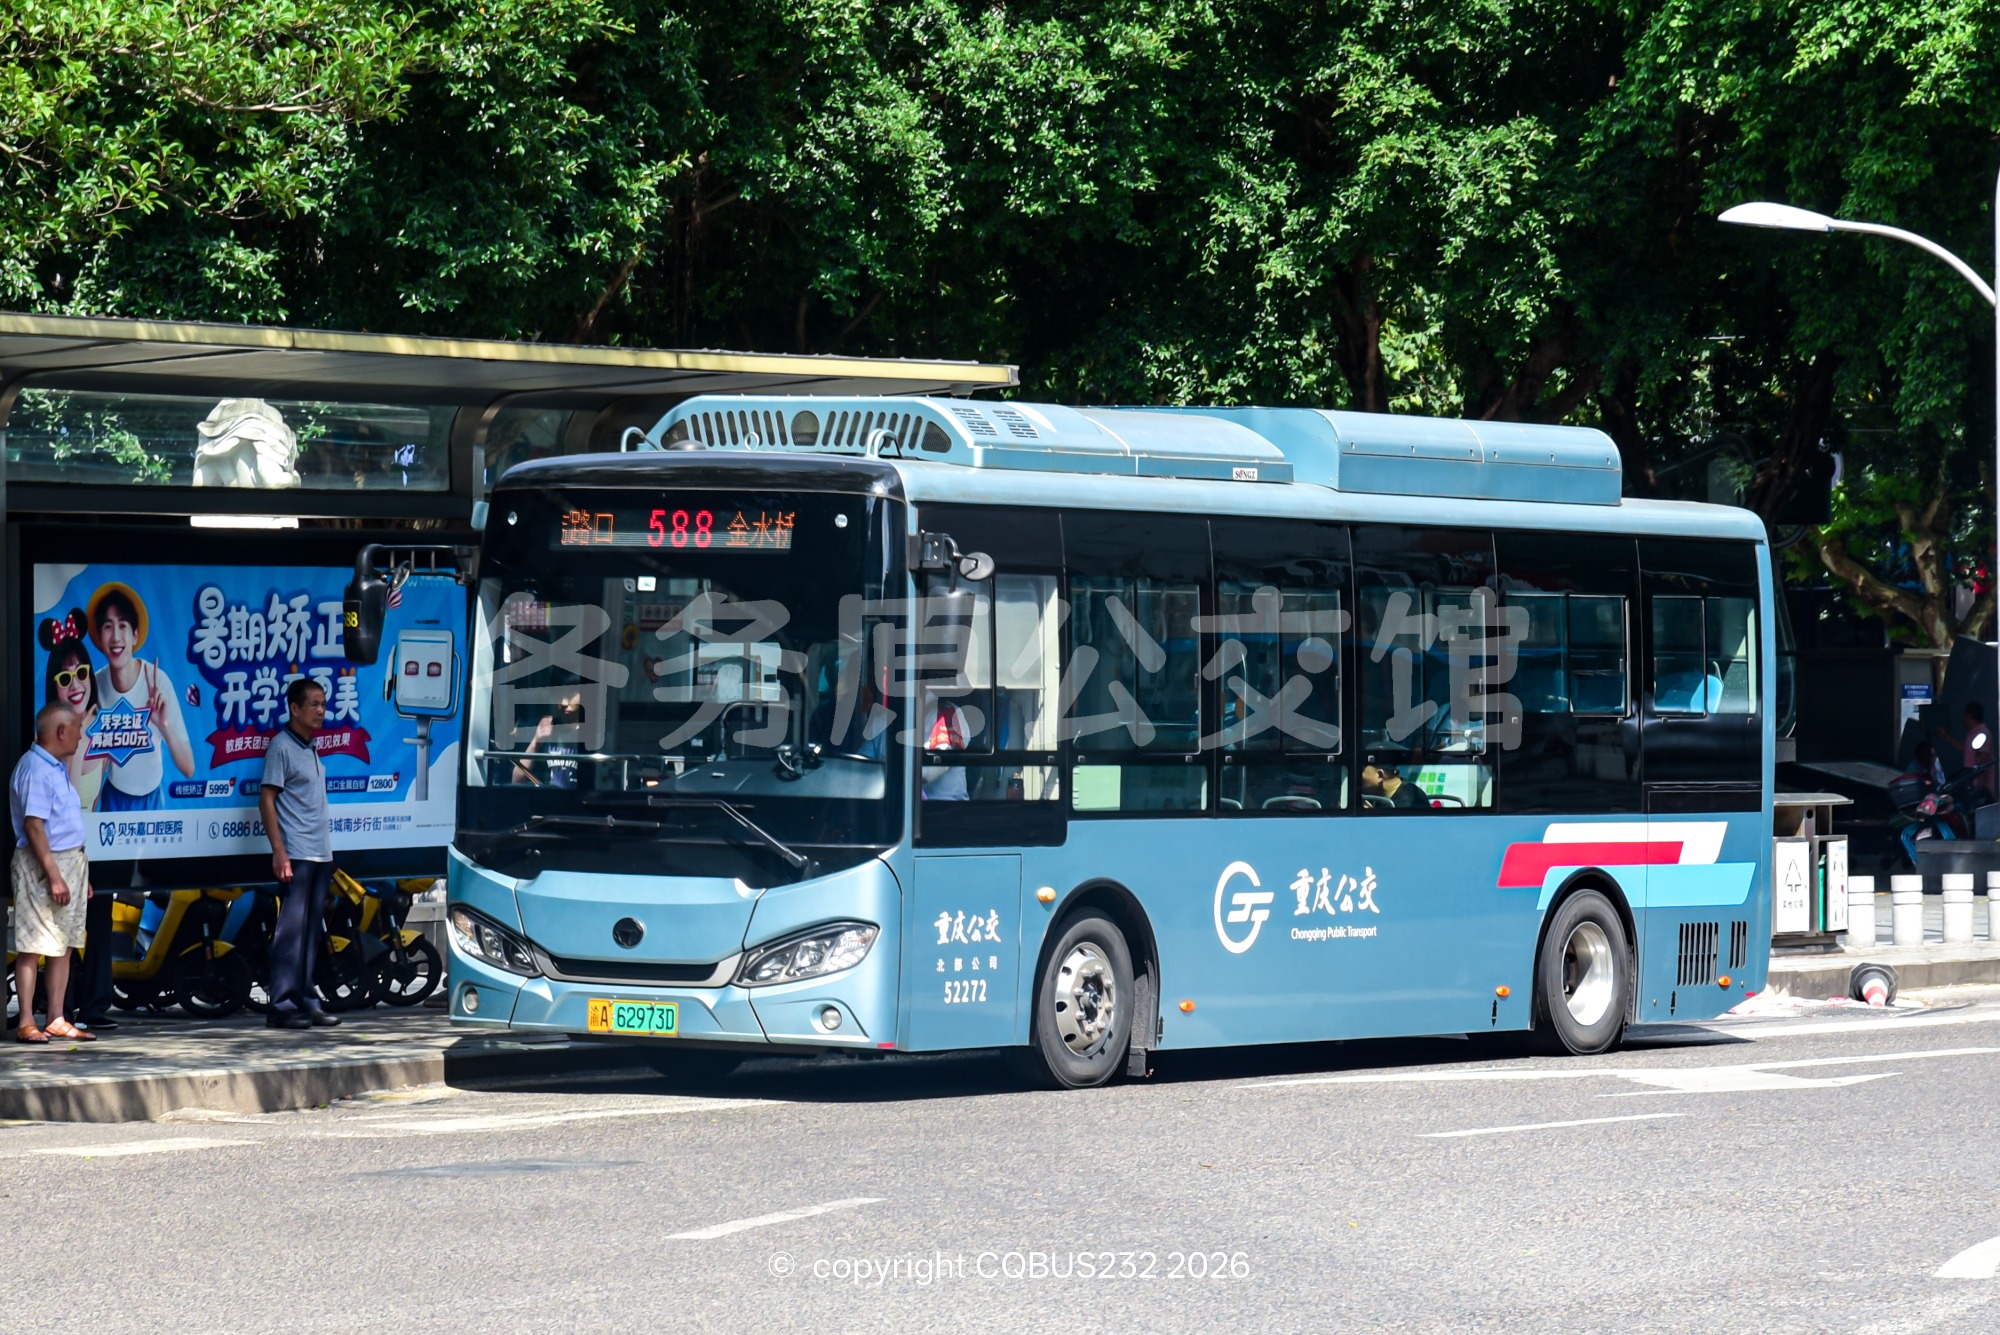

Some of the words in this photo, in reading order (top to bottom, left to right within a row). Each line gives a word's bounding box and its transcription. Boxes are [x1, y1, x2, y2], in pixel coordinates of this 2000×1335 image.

[647, 509, 713, 548] 588
[193, 586, 346, 669] 暑期矫正
[101, 713, 143, 731] 凭学生证
[92, 731, 149, 748] 再减500元
[209, 783, 230, 795] 5999
[370, 778, 393, 790] 12800
[118, 820, 184, 837] 贝乐嘉口腔医院
[222, 821, 250, 838] 6886
[1289, 866, 1381, 916] 重庆公交
[933, 908, 1002, 945] 重庆公交
[1291, 927, 1327, 942] Chongqing
[1327, 926, 1347, 938] Public
[1347, 925, 1377, 940] Transport
[936, 955, 998, 973] 北部公司
[944, 979, 987, 1004] 52272
